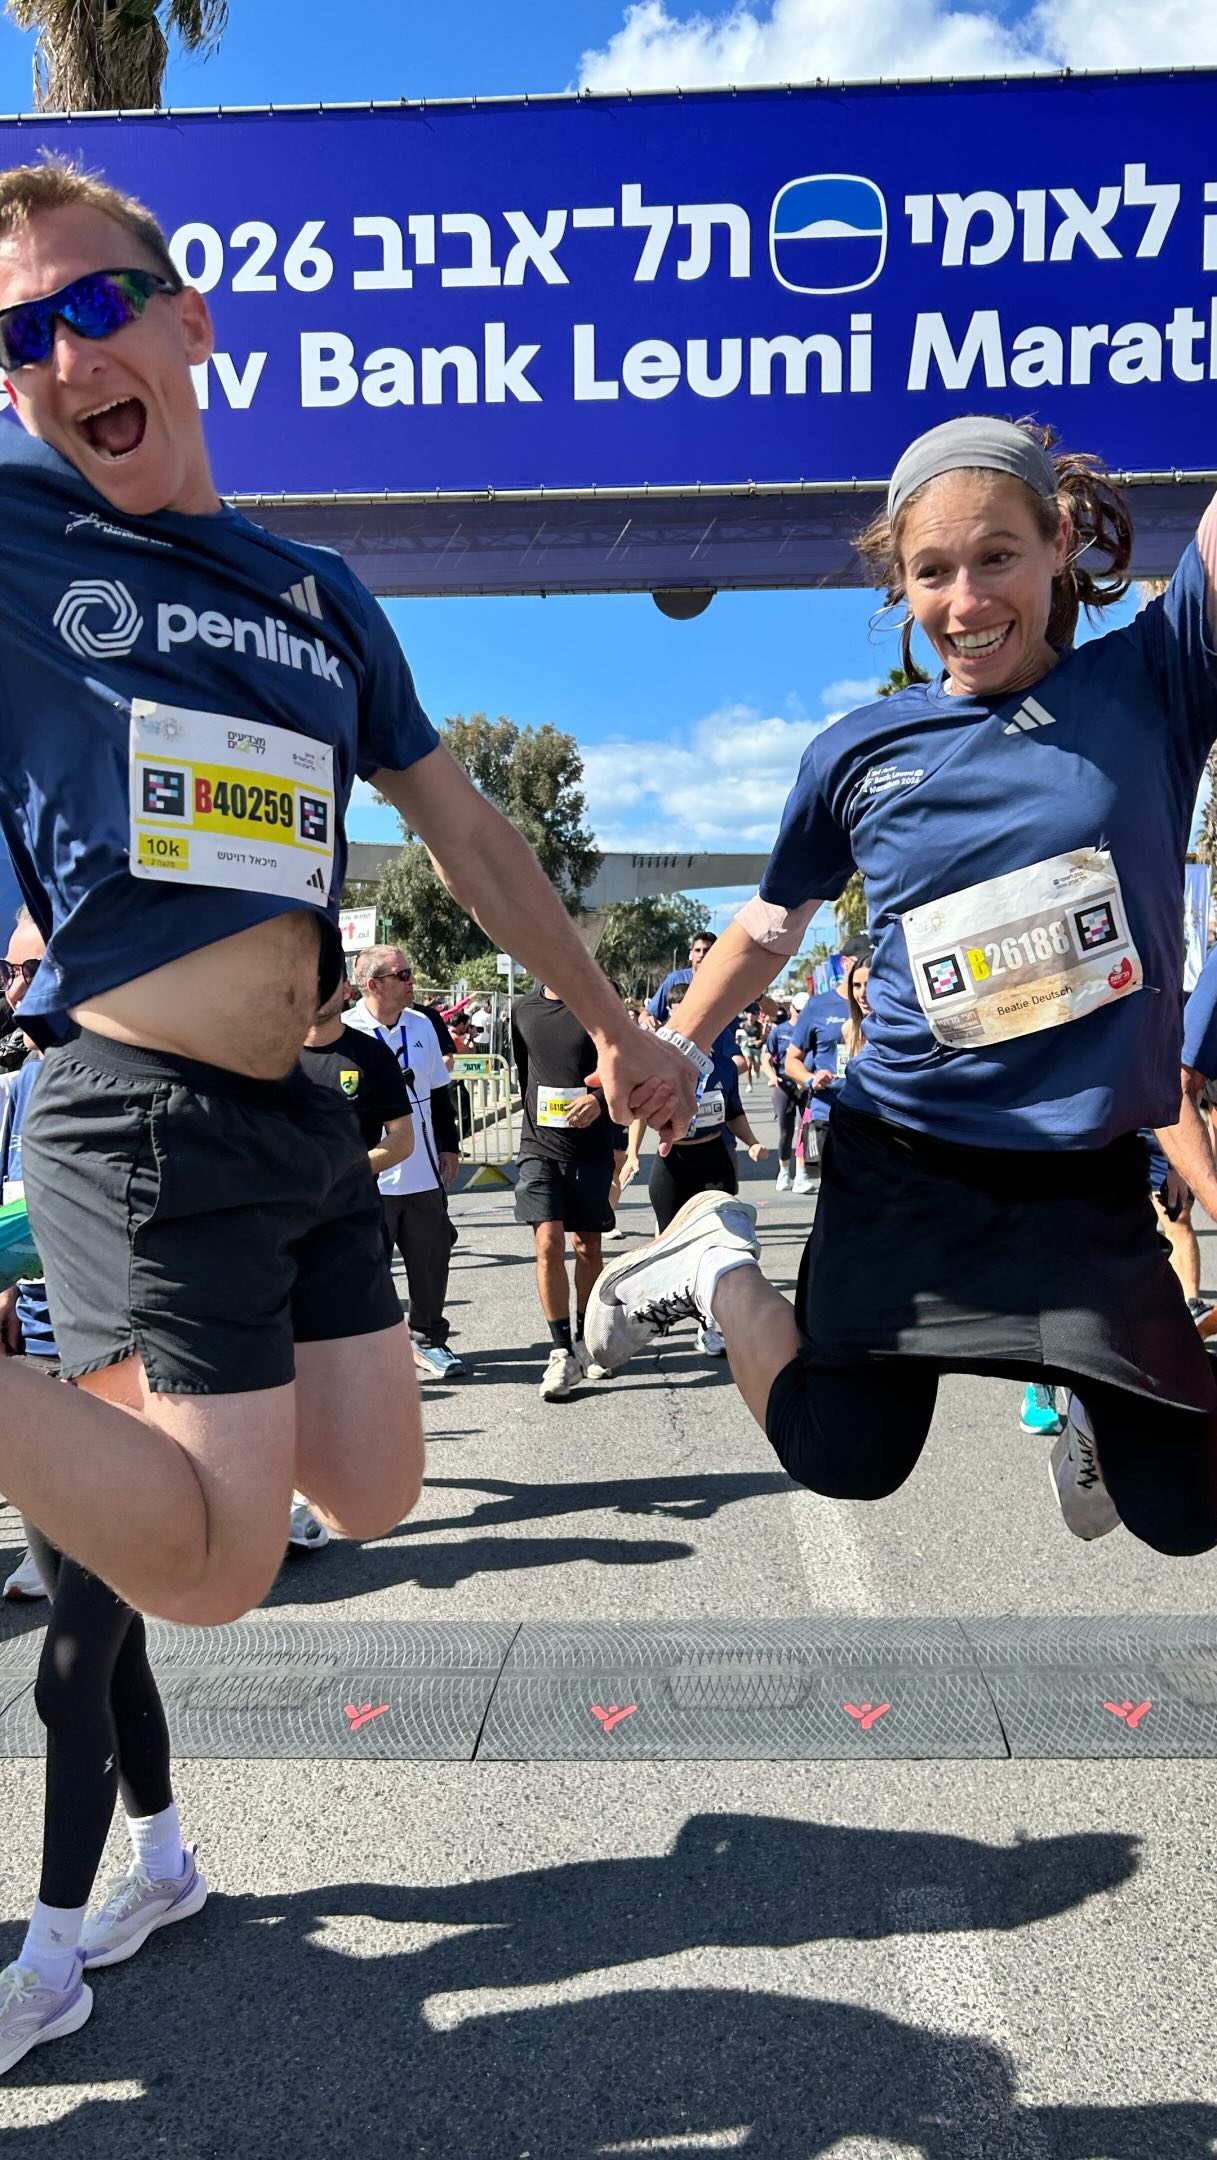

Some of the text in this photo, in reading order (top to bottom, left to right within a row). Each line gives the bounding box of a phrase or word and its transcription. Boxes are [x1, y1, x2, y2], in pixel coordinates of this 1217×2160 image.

[905, 164, 1179, 265] לאומי
[169, 221, 333, 294] 026
[190, 353, 267, 409] iv
[301, 323, 542, 407] Bank
[574, 314, 871, 400] Leumi
[157, 601, 343, 688] penlink
[228, 740, 266, 755] לרים
[194, 777, 294, 829] B40259
[147, 839, 180, 857] 10k
[217, 850, 277, 868] מיכאל דויטש
[966, 920, 1071, 982] B26188
[997, 984, 1073, 1016] Beatie Deutsch
